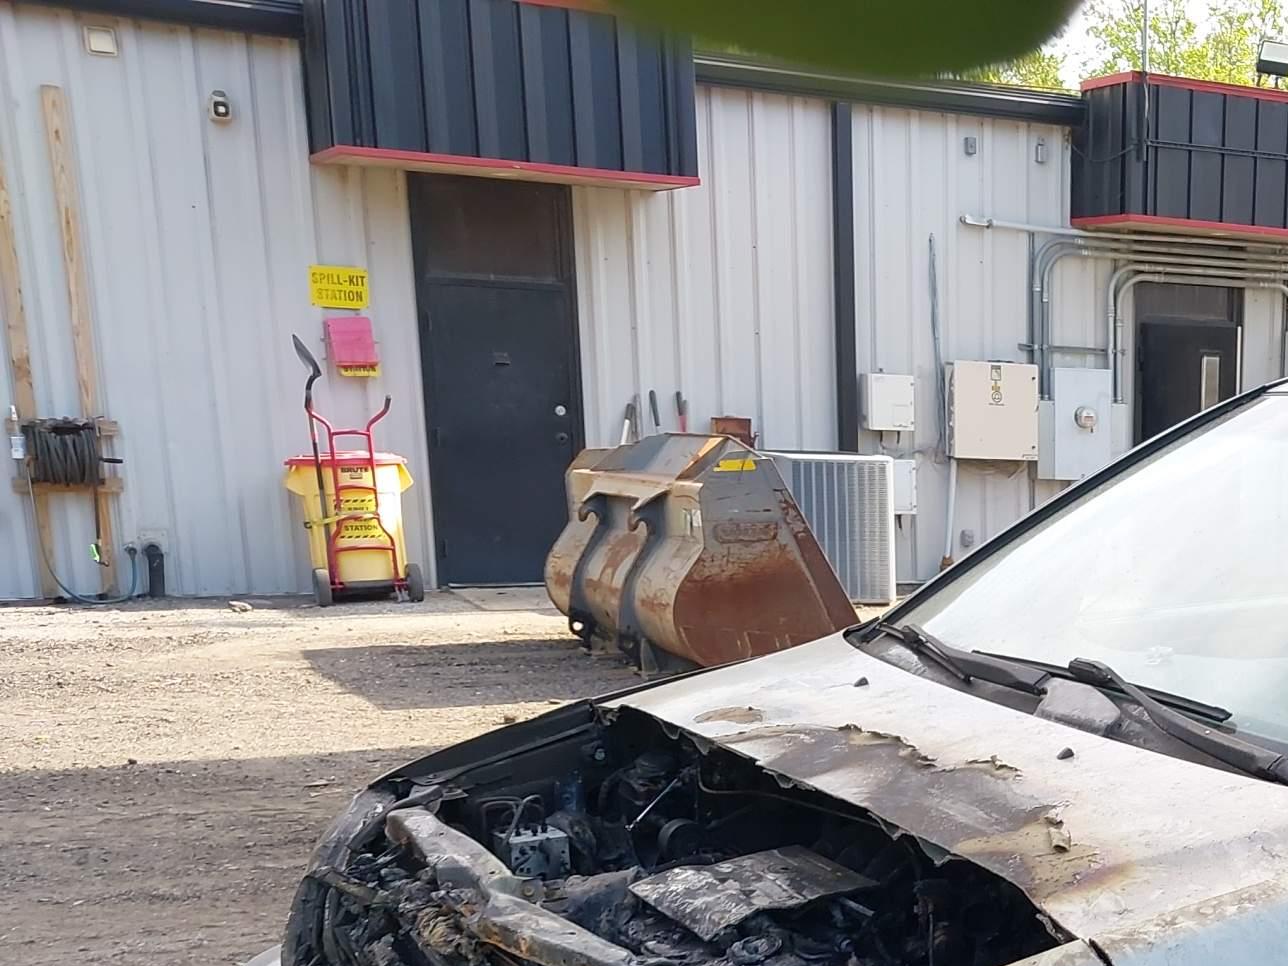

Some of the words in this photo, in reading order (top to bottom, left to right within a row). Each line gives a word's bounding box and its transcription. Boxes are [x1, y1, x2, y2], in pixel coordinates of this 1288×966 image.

[311, 272, 366, 287] SPILL-KIT
[316, 288, 363, 302] STATION
[344, 524, 378, 532] STATION
